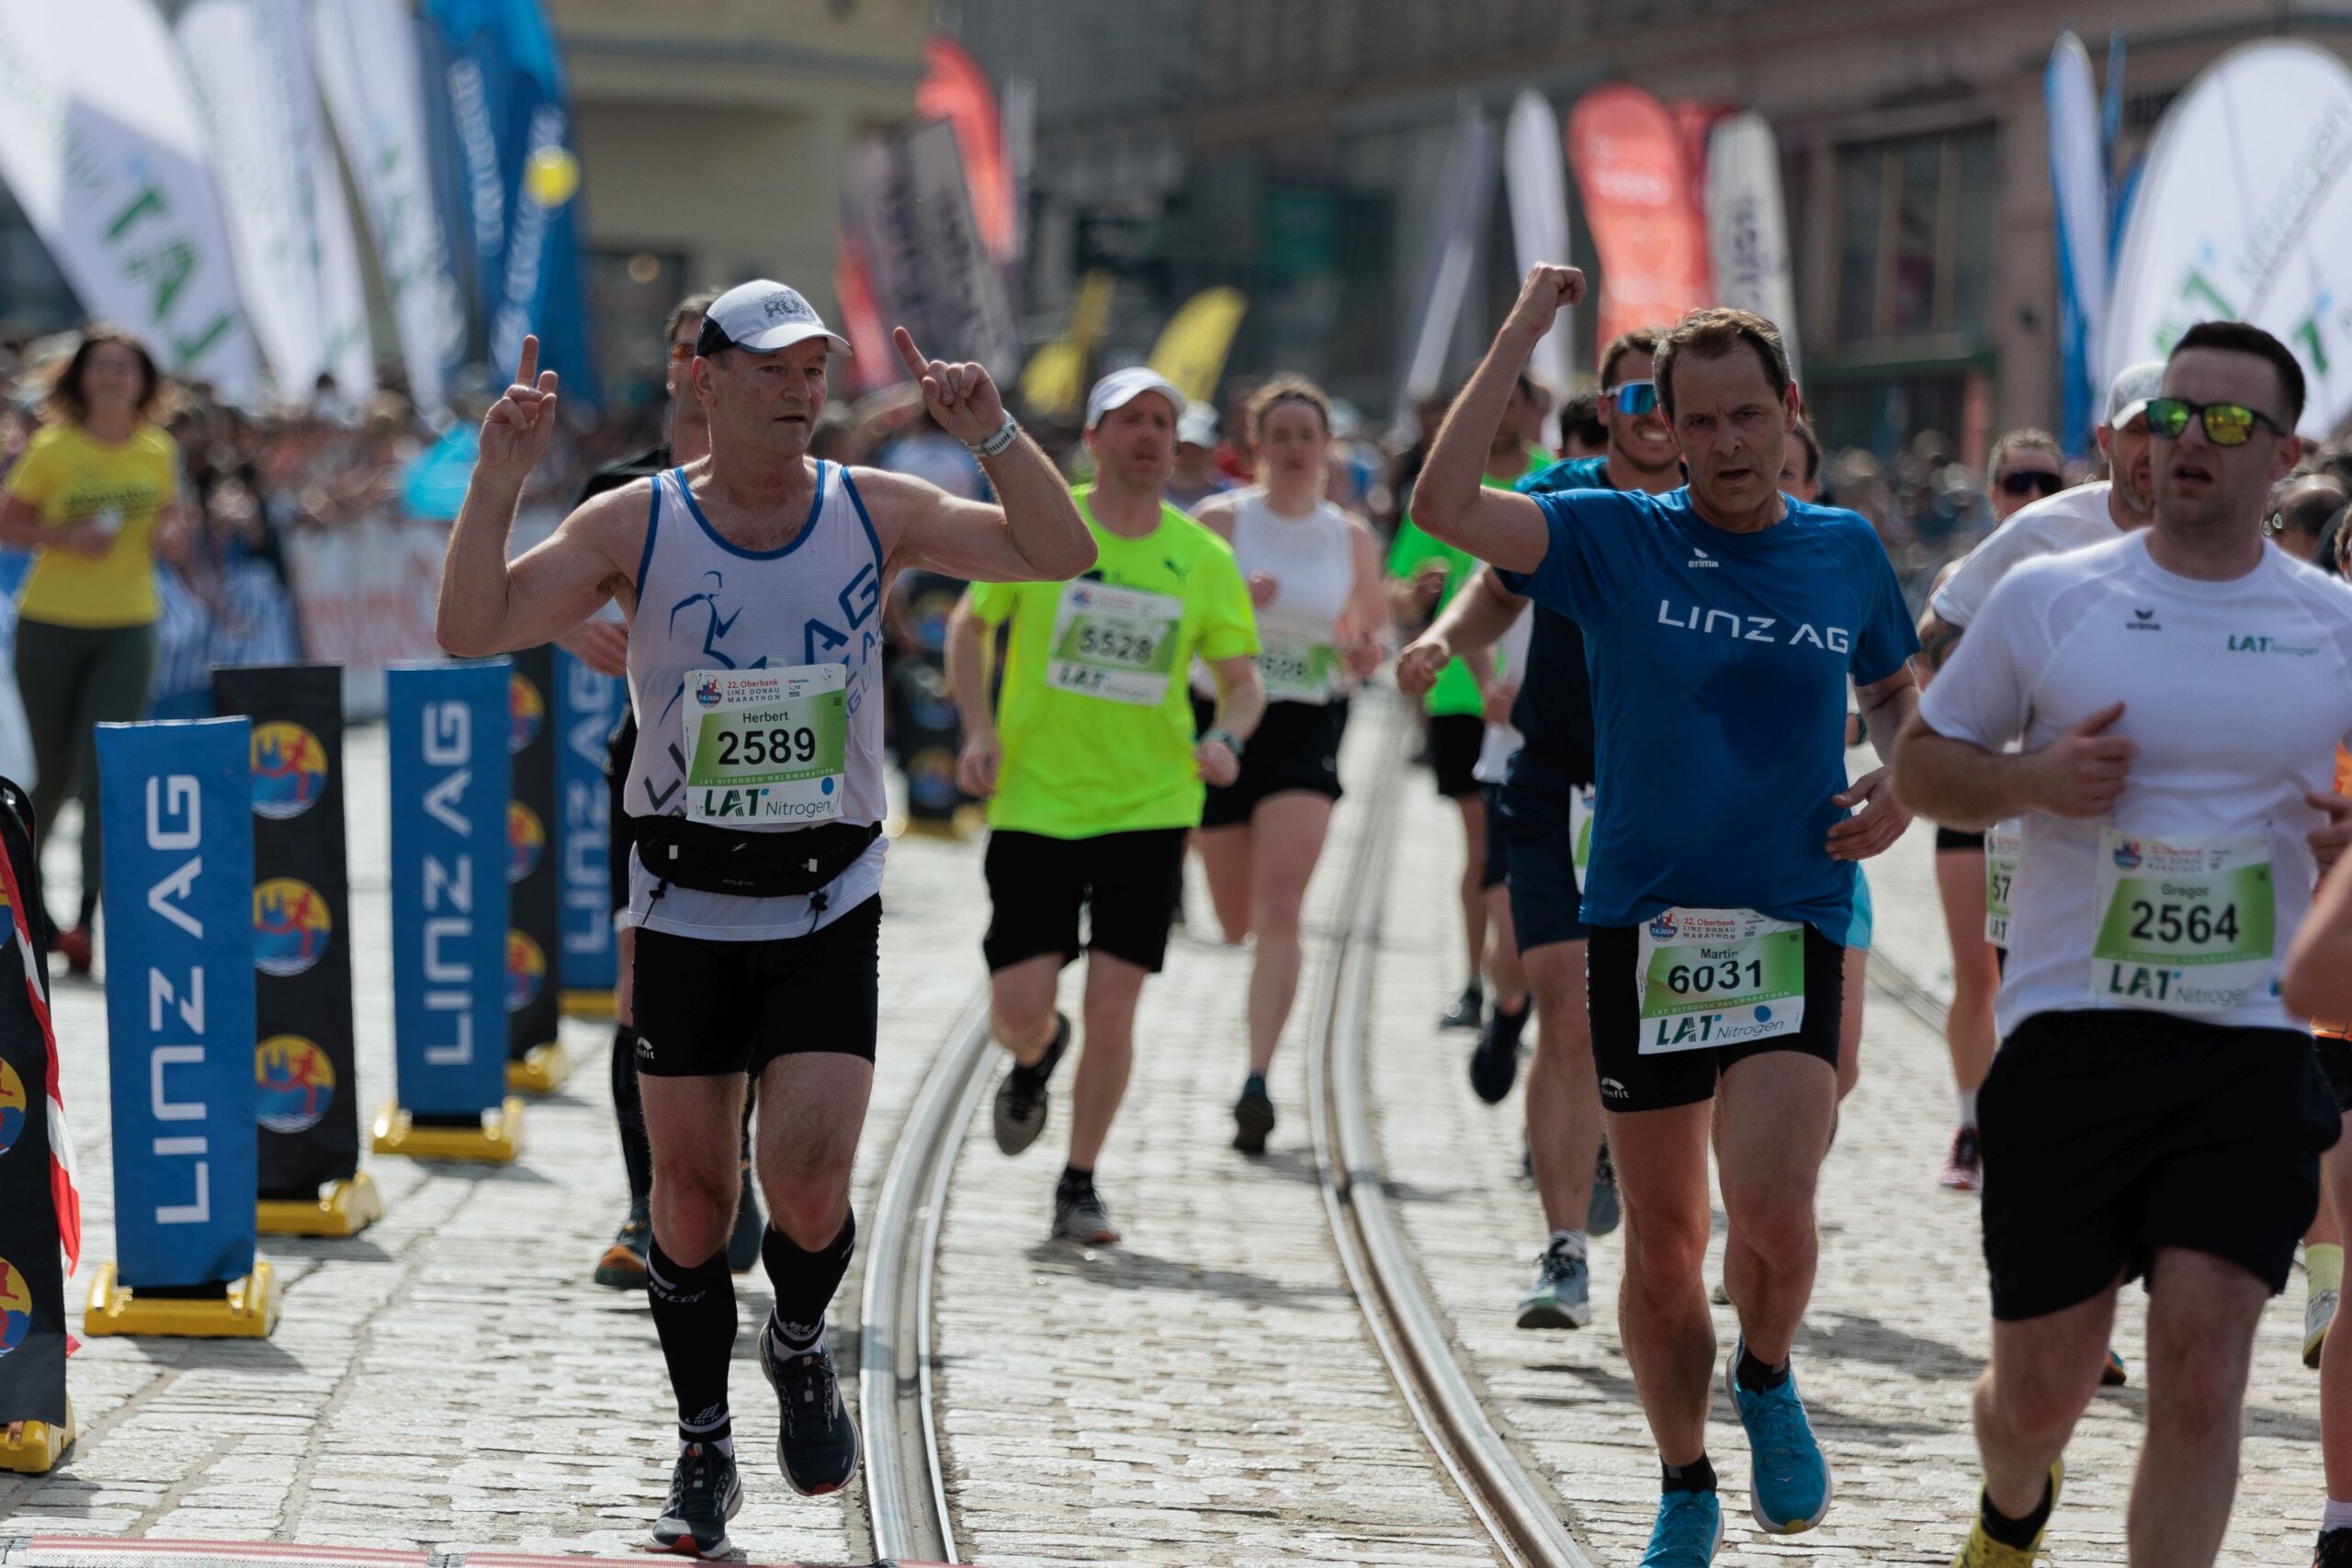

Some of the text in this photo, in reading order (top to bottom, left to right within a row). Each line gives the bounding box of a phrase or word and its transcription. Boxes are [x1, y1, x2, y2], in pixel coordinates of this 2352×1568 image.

[1688, 559, 1719, 568] erima
[1657, 600, 1849, 654] LINZ AG
[1080, 626, 1152, 664] 5528
[2227, 635, 2269, 653] LAT
[727, 681, 740, 689] 22.
[741, 679, 779, 688] Oberbank
[750, 687, 780, 695] DONAU
[727, 695, 781, 704] MARATHON
[742, 711, 789, 724] Herbert
[718, 727, 816, 765] 2589
[718, 776, 763, 785] NITROGEN
[768, 768, 835, 782] HALBMARATHON
[705, 788, 831, 818] LAT Nitrogen
[563, 777, 613, 954] LINZ
[422, 699, 474, 1066] LINZ AG
[2161, 884, 2209, 899] Gregor
[1683, 931, 1736, 940] MARATHON
[1697, 918, 1736, 927] Oberbank
[2130, 900, 2239, 944] 2564
[1668, 959, 1761, 994] 6031
[2109, 964, 2171, 1000] LAT
[146, 774, 210, 1224] LINZ AG
[1652, 991, 1790, 1017] LAT NITROGEN HALBMARATHON
[1656, 1014, 1784, 1045] LAT Nitrogen
